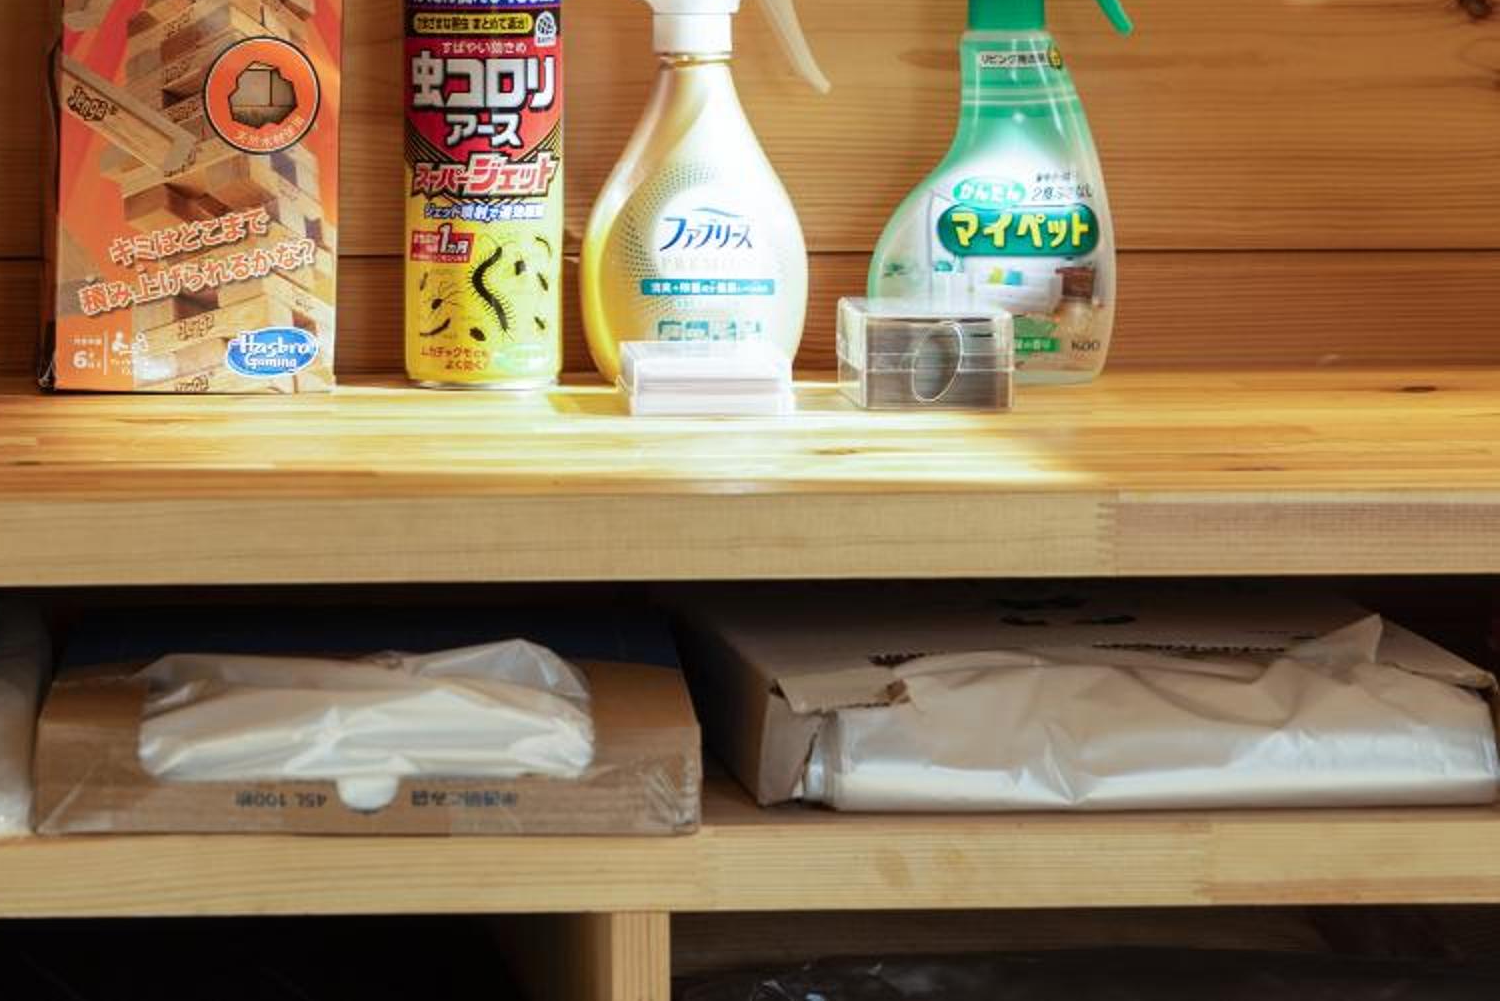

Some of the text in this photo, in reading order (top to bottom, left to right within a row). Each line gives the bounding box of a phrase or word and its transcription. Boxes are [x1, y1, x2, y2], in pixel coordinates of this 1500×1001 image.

[442, 42, 527, 54] すばやい効きめ
[411, 50, 556, 109] 虫コロリ
[446, 114, 523, 147] アース
[414, 153, 558, 194] スーパージェット
[957, 181, 1021, 202] かんたん
[109, 207, 271, 268] キミはどこまで
[951, 210, 1091, 248] マイペット
[236, 332, 312, 357] Hasbro
[245, 353, 298, 372] Gaming
[295, 793, 327, 807] 45L
